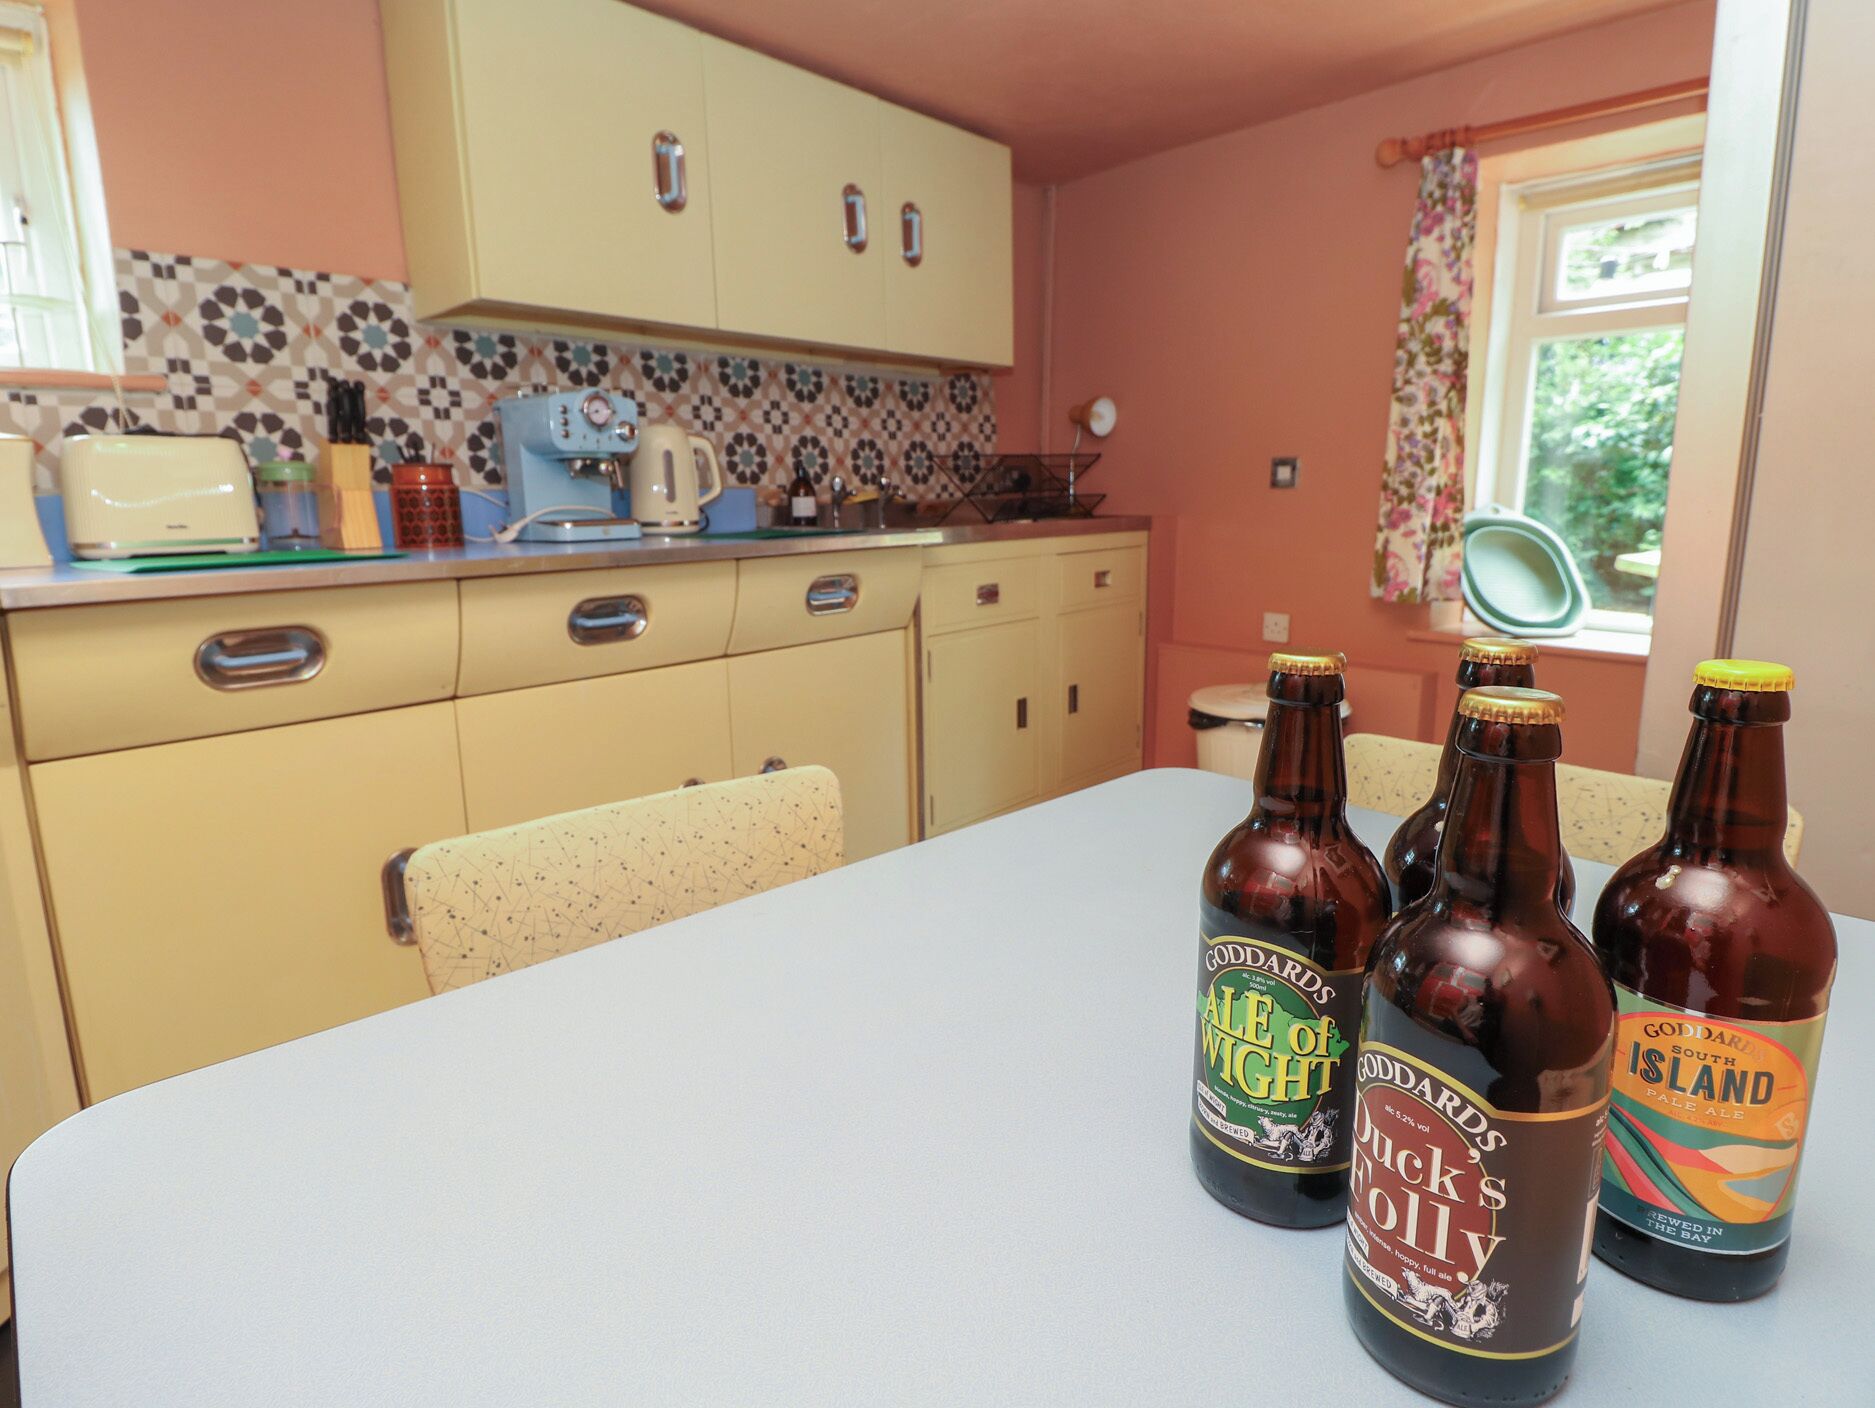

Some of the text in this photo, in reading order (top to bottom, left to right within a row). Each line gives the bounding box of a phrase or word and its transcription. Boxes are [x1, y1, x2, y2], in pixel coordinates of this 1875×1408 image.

[1205, 944, 1336, 1004] GODDARDS
[1250, 982, 1266, 991] 500ml
[1252, 974, 1265, 984] 3.8%
[1204, 983, 1336, 1057] ALE of
[1200, 1016, 1341, 1102] WIGHT
[1671, 1045, 1736, 1066] SOUTH
[1628, 1040, 1775, 1108] ISLAND
[1357, 1053, 1508, 1152] GODDARDS
[1646, 1088, 1744, 1120] PALE ALE
[1220, 1120, 1250, 1138] BREWED
[1384, 1104, 1430, 1134] alc 5.2% vol
[1353, 1089, 1507, 1210] Duck's
[1348, 1130, 1507, 1285] Folly
[1646, 1218, 1712, 1244] THE BAY
[1707, 1226, 1723, 1236] IN
[1362, 1262, 1392, 1289] BREWED
[1423, 1264, 1436, 1277] full
[1438, 1270, 1452, 1282] ale
